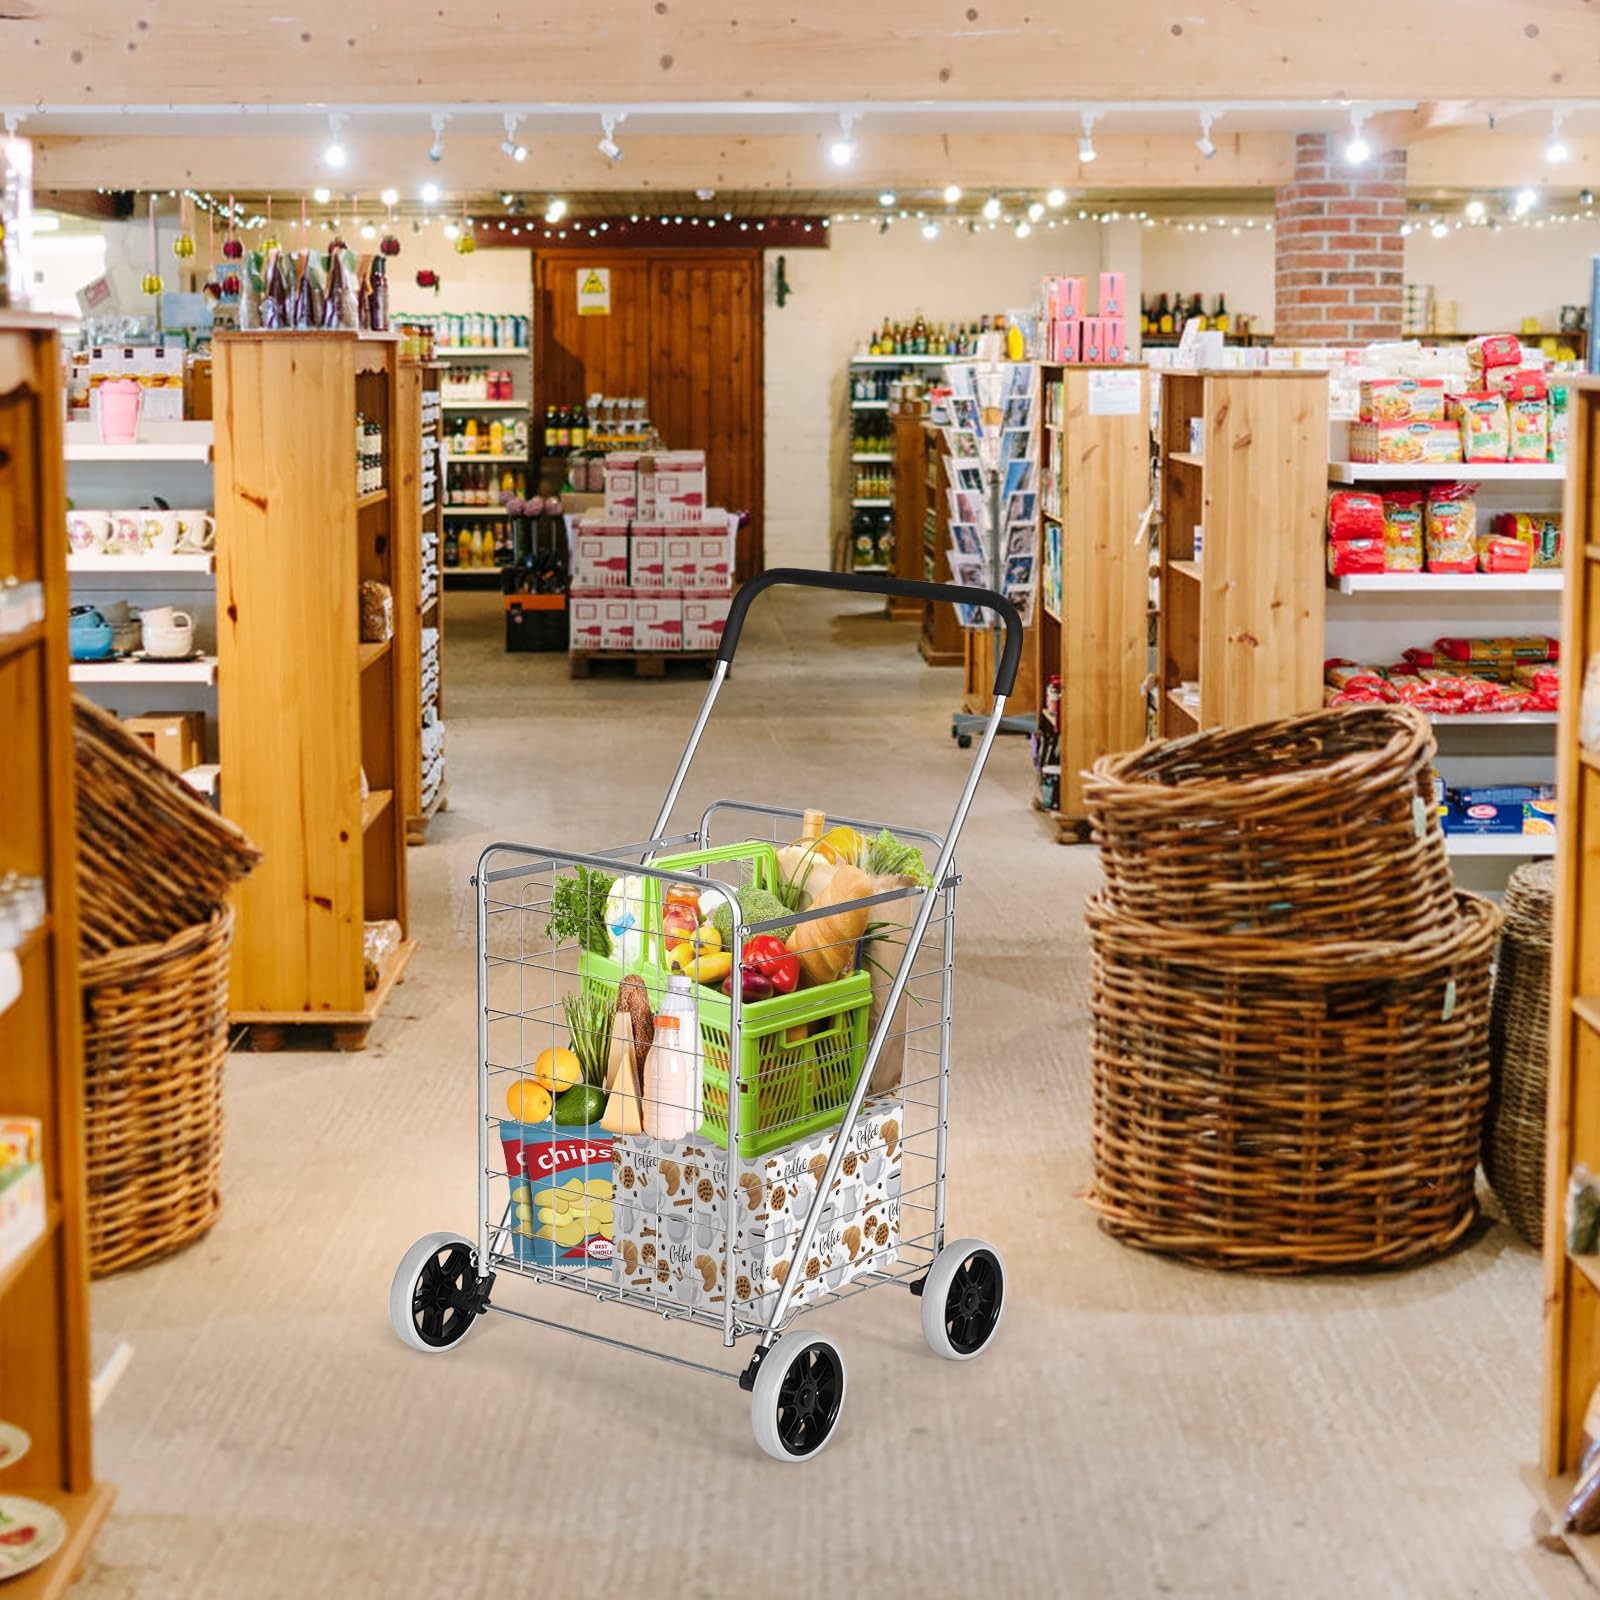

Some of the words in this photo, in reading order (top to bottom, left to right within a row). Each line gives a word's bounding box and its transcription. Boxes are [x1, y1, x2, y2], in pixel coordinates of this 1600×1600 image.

[857, 1121, 879, 1150] Coffee
[538, 1145, 612, 1170] chips
[634, 1150, 657, 1172] Coffee
[784, 1157, 808, 1184] Coffee
[819, 1228, 841, 1257] Coffee
[670, 1244, 692, 1269] Coffee
